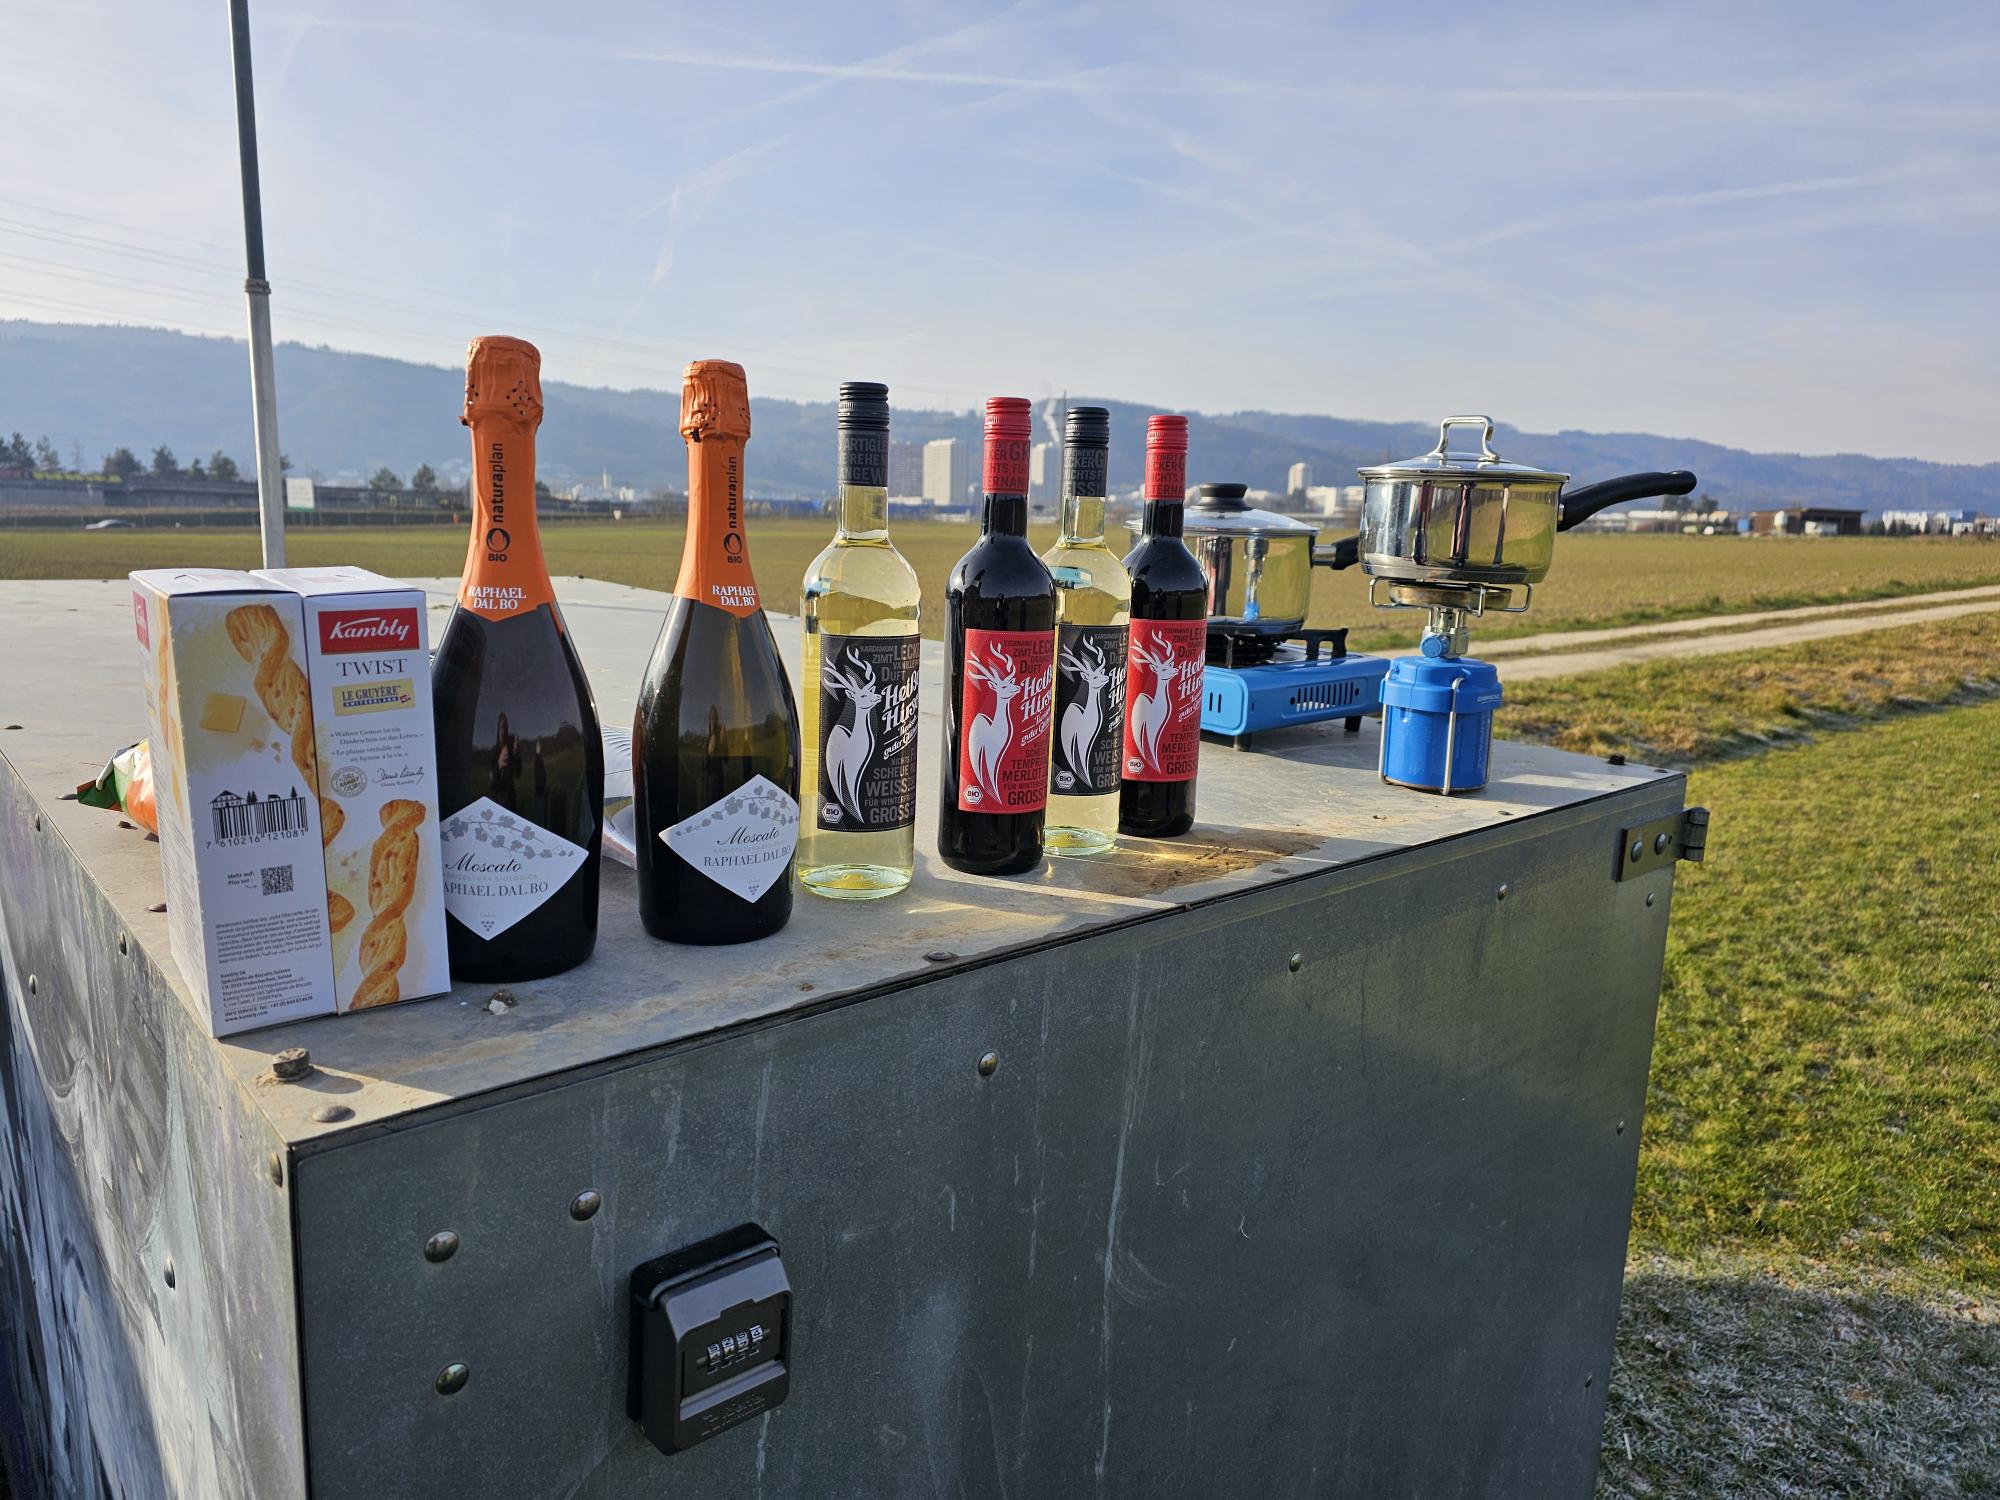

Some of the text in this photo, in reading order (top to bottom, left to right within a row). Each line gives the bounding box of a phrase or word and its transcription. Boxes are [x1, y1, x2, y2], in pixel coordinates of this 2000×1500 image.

[489, 443, 506, 523] naturaplan
[726, 457, 738, 528] naturaplan
[488, 553, 508, 563] BIO
[727, 555, 742, 564] BIO
[468, 585, 526, 599] RAPHAEL
[712, 585, 755, 597] RAPHAEL
[473, 598, 518, 609] DAL BO
[721, 596, 755, 606] DAL BO
[329, 617, 410, 640] Kambly
[872, 653, 893, 664] ZIMT
[336, 658, 407, 677] TWIST
[881, 666, 906, 682] DUFT
[1019, 660, 1041, 674] DUFT
[342, 685, 399, 701] LE GRUYÈRE
[1002, 768, 1041, 783] MERLOT
[865, 778, 908, 797] WEISS
[870, 803, 910, 824] GROSS
[206, 829, 305, 849] 7 610216 121081
[717, 825, 779, 845] Moscato
[445, 852, 521, 872] Moscato
[704, 854, 761, 867] RAPHAEL
[763, 849, 780, 862] DAL
[444, 881, 548, 897] APHAEL DAL BO
